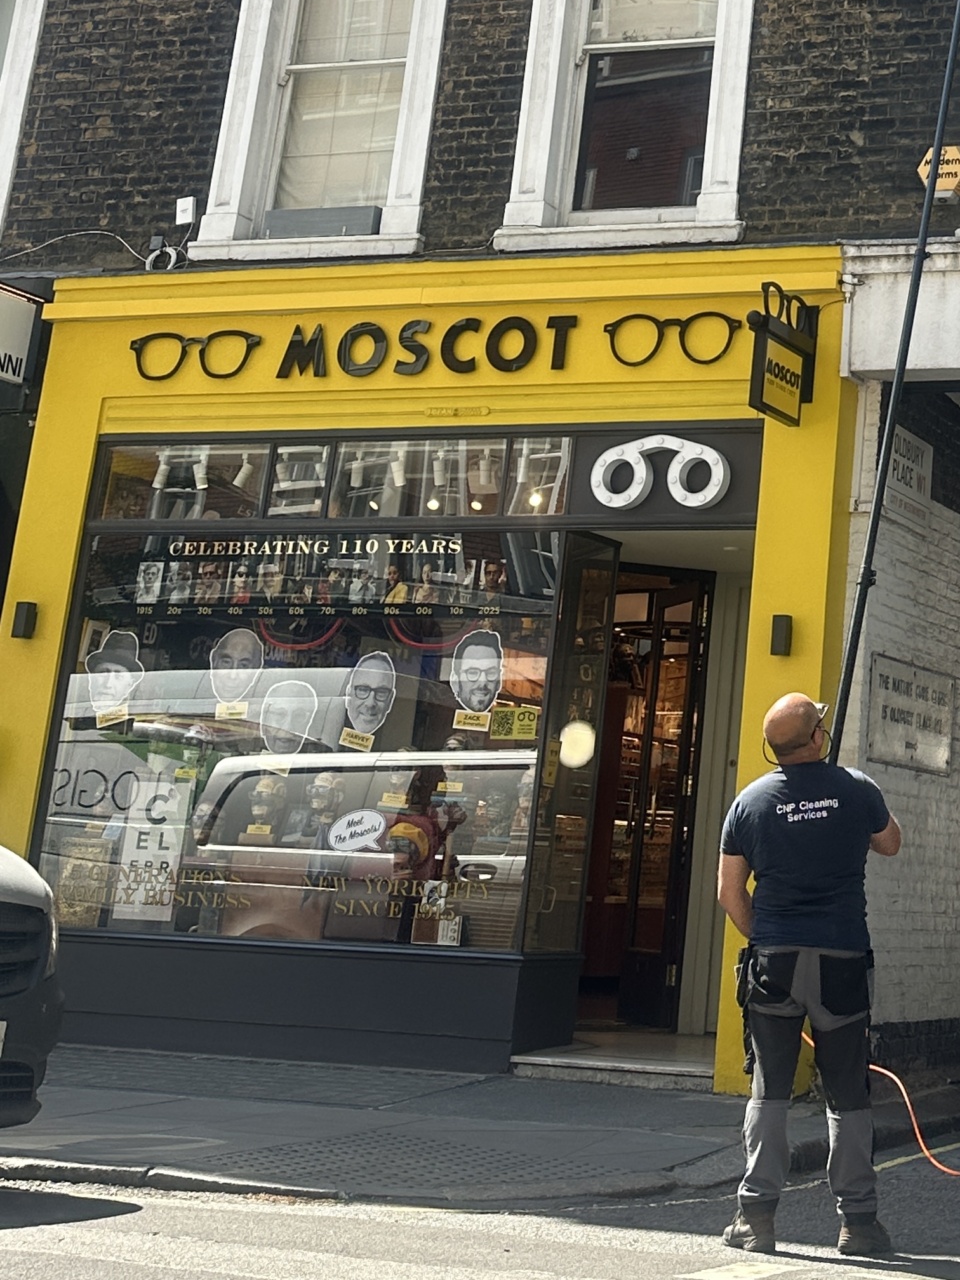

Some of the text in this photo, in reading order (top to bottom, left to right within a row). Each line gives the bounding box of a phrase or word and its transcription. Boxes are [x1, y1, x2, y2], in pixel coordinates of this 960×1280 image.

[923, 157, 960, 167] Mdern
[276, 314, 579, 379] MOSCOT
[766, 357, 801, 390] MOSCOT
[894, 433, 925, 469] OLDBURY
[892, 458, 914, 489] PLACE
[169, 539, 462, 556] CELEBRATING 110 YEARS
[136, 606, 500, 615] 1915 20s 30s 40s 50s 60s 70s 80s 90s 00s 10s 2025
[879, 673, 890, 690] THE
[892, 677, 914, 698] NATURE
[463, 714, 481, 722] ZACK
[345, 731, 370, 743] HARVEY
[145, 794, 170, 825] C
[776, 798, 839, 814] CNP Cleaning
[787, 810, 828, 822] Services
[334, 821, 382, 845] The Moscots!
[346, 816, 364, 829] Meet
[89, 863, 242, 886] GENERATIONS
[59, 884, 136, 905] FAMILY
[141, 888, 252, 909] BUSINESS
[301, 875, 494, 900] NEW YORK CITY
[334, 899, 456, 921] SINCE 1915
